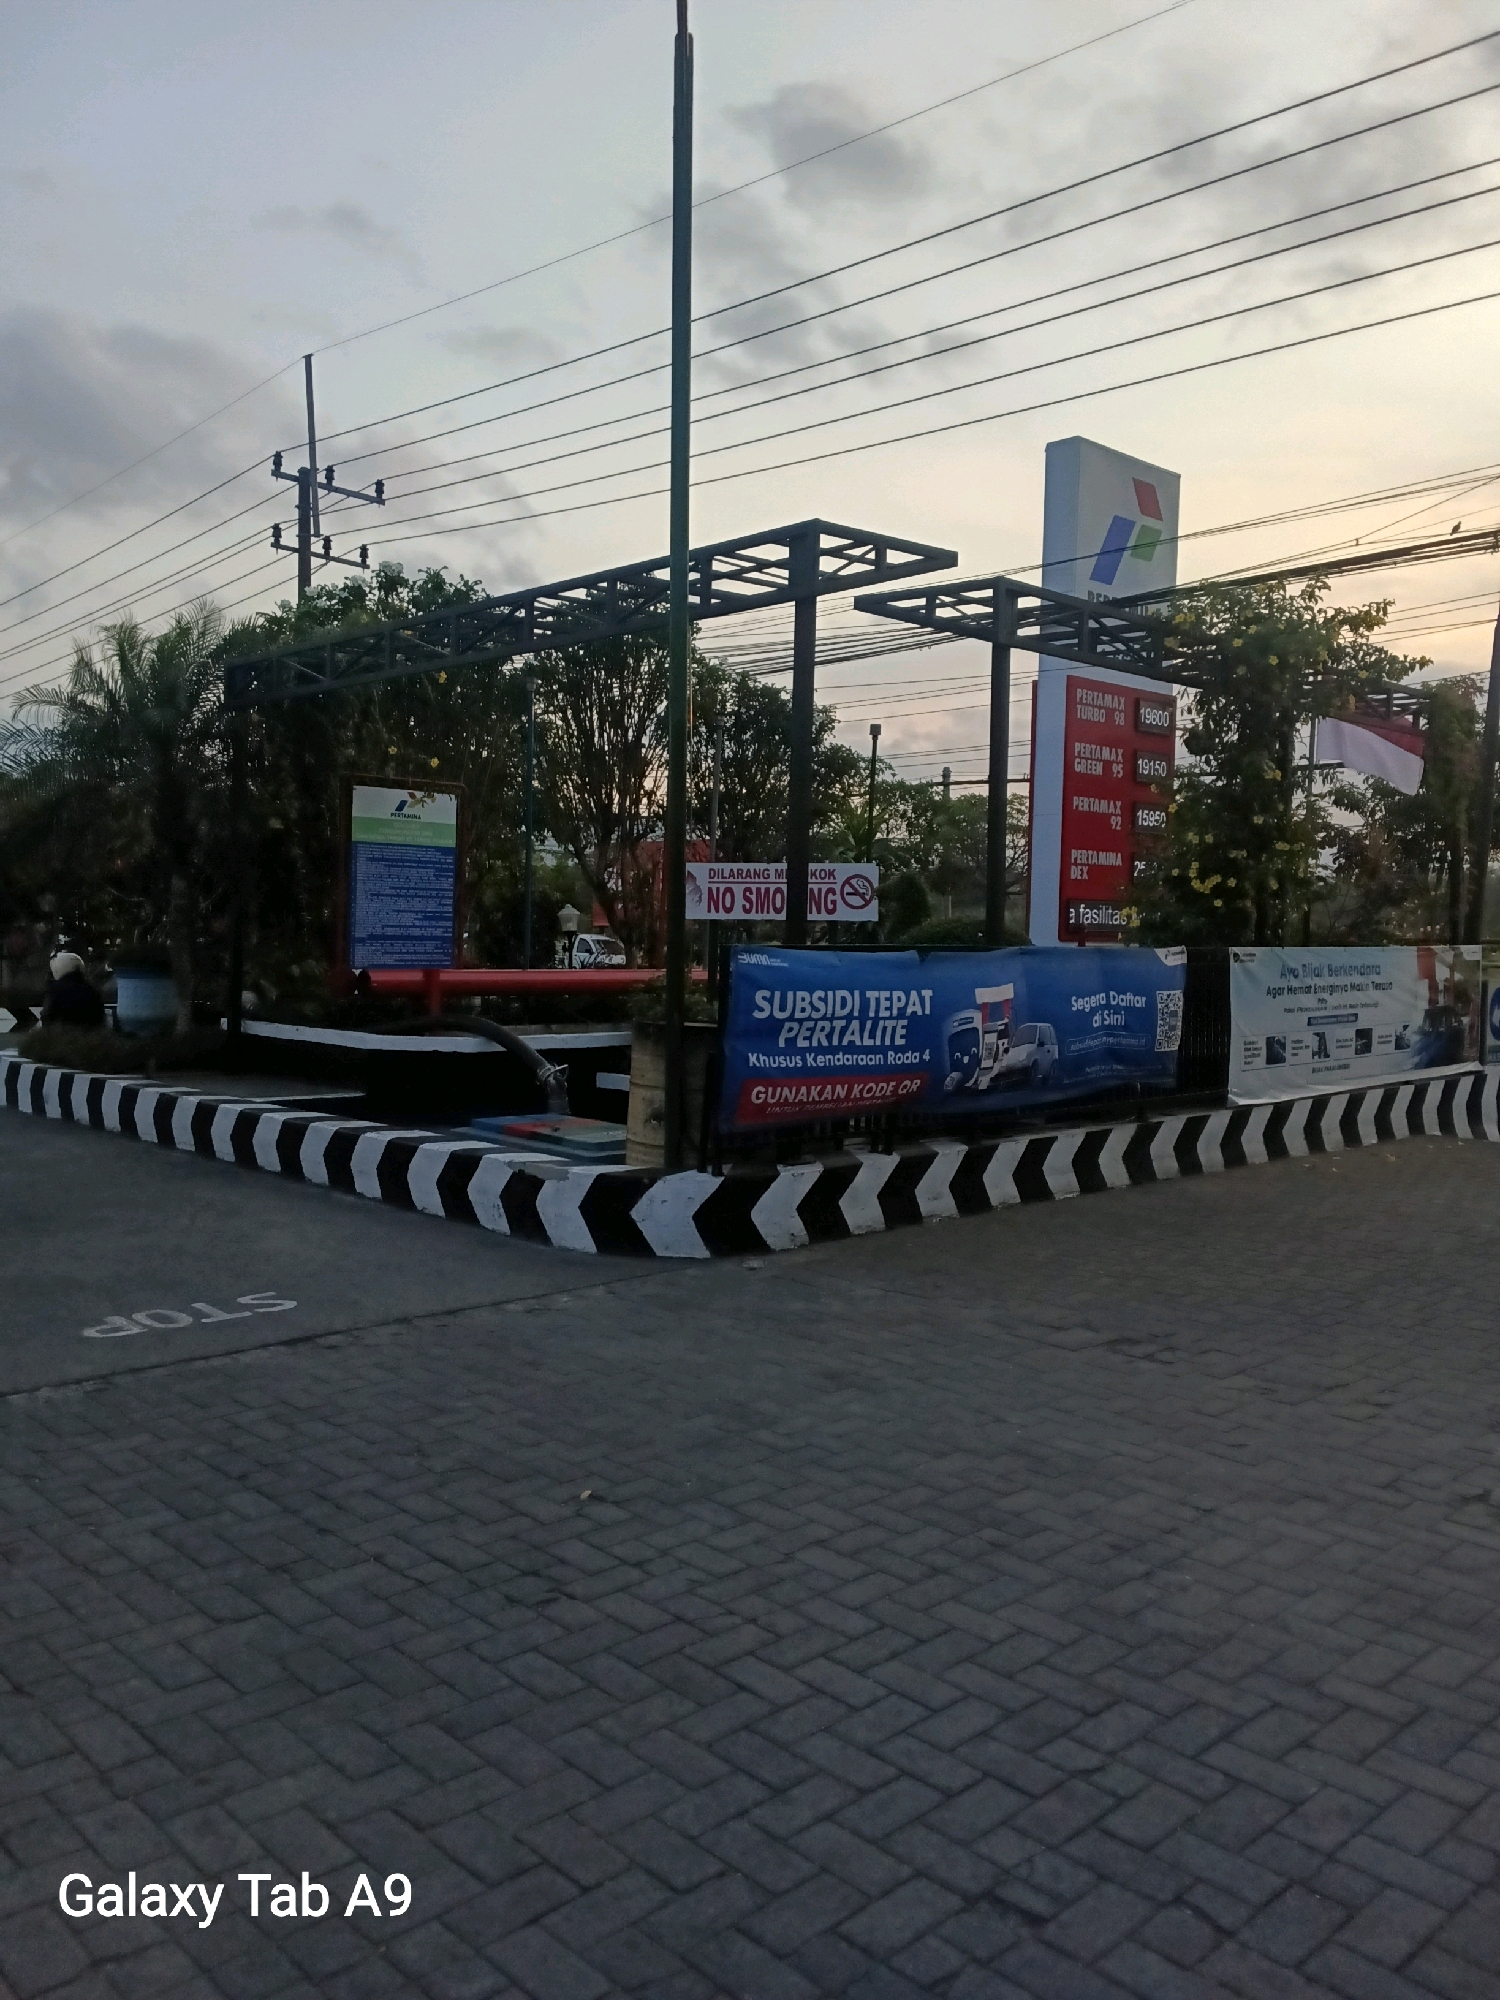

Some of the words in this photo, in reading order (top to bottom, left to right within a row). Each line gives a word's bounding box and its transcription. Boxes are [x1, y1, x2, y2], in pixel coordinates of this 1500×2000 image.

[1077, 688, 1125, 711] PERTAMAX
[1077, 705, 1105, 722] TURBO
[1114, 711, 1125, 726] 98
[1140, 707, 1170, 727] 19600
[1074, 742, 1123, 762] PERTAMAX
[1074, 758, 1103, 776] GREEN
[1112, 763, 1123, 778] 95
[1138, 759, 1167, 777] 19150
[1073, 796, 1122, 814] PERTAMAX
[391, 812, 421, 820] PERTAMINA
[1110, 816, 1122, 830] 92
[1137, 809, 1166, 828] 15950
[1071, 849, 1122, 866] PERTAMINA
[708, 868, 771, 880] DILARANG
[1070, 866, 1088, 880] DEX
[707, 886, 735, 914] NO
[742, 886, 837, 915] SMONG
[1280, 964, 1300, 981] Ayo
[1303, 963, 1325, 980] Bijak
[1328, 963, 1381, 978] Berkendara
[1266, 986, 1285, 999] Agar
[1287, 985, 1312, 996] Hemat
[1313, 984, 1349, 996] Energinya
[1350, 982, 1370, 993] Makin
[1371, 981, 1393, 991] Terasa
[752, 989, 860, 1020] SUBSIDI
[865, 989, 933, 1018] TEPAT
[1071, 992, 1106, 1012] Segera
[1110, 991, 1146, 1008] Daftar
[1092, 1011, 1101, 1027] di
[1104, 1010, 1125, 1026] Sini
[778, 1019, 908, 1048] PERTALITE
[748, 1053, 803, 1068] Khusus
[806, 1050, 884, 1067] Kendaraan
[887, 1050, 920, 1065] Roda
[923, 1049, 930, 1062] 4
[751, 1084, 848, 1104] GUNAKAN
[850, 1081, 896, 1098] KODE
[898, 1079, 921, 1095] QR
[83, 1291, 298, 1338] STOP
